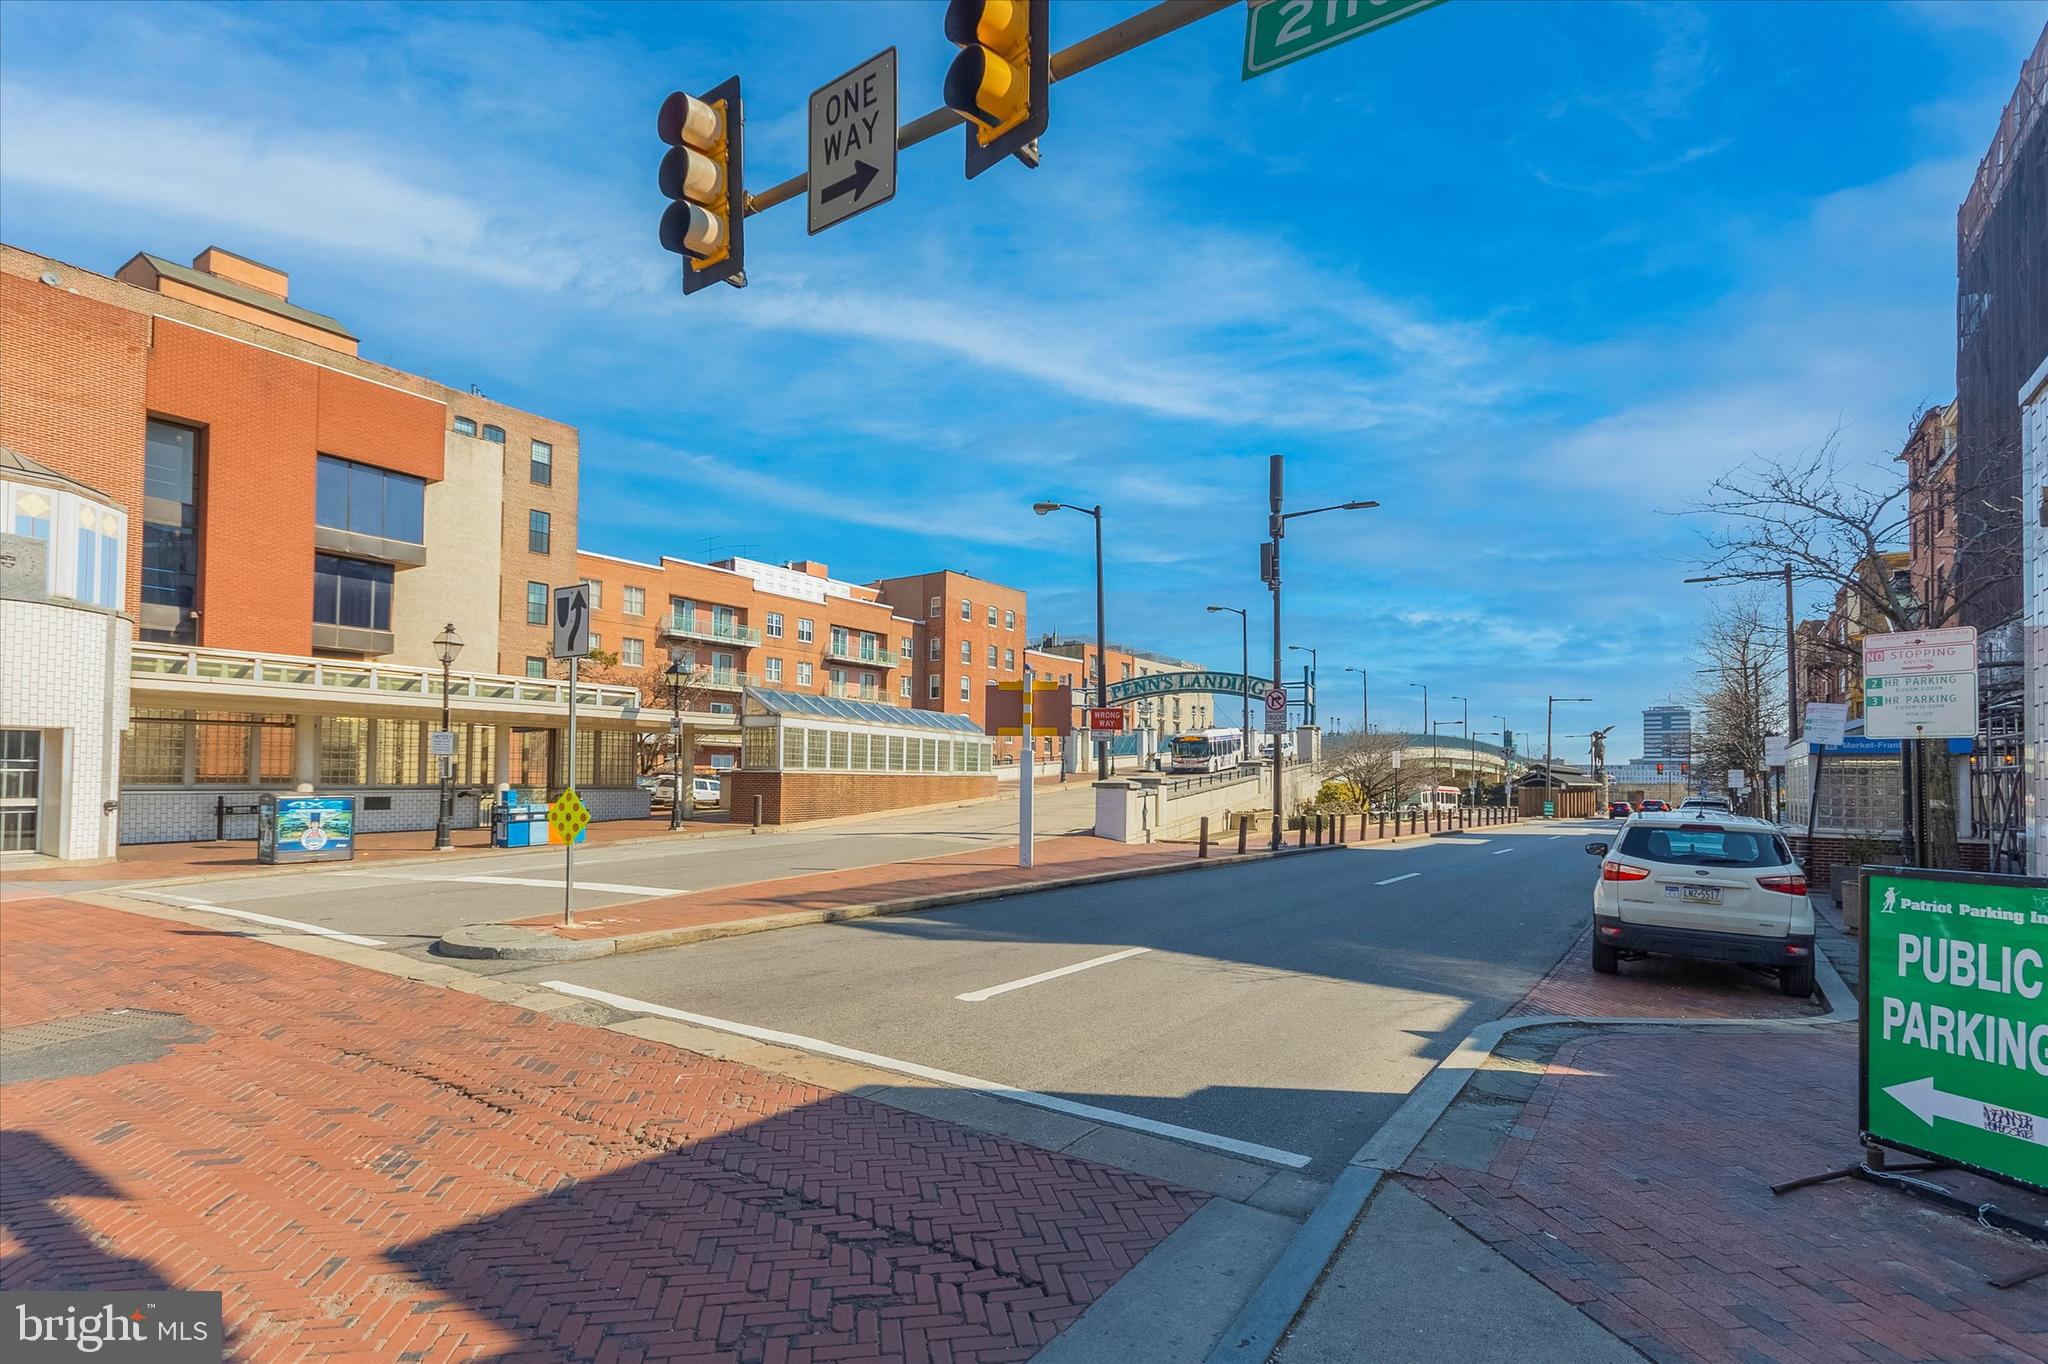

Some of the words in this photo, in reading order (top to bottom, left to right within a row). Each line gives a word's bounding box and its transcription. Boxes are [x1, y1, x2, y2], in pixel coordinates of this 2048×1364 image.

[826, 72, 878, 126] ONE
[824, 110, 879, 166] WAY
[1866, 652, 1884, 662] NO
[1890, 647, 1956, 660] STOPPING
[1110, 675, 1173, 699] PENN'S
[1179, 673, 1265, 695] LANDING
[1871, 679, 1877, 688] 2
[1884, 679, 1899, 688] HR
[1905, 675, 1957, 686] PARKING
[1871, 698, 1878, 706] 3
[1885, 696, 1900, 705] HR
[1905, 693, 1957, 704] PARKING
[1094, 711, 1121, 719] WRONG
[1098, 719, 1116, 728] WAY
[1901, 897, 1953, 914] Patriot
[1959, 903, 2025, 925] Parking
[1898, 932, 2044, 999] PUBLIC
[1882, 995, 2048, 1077] PARKING
